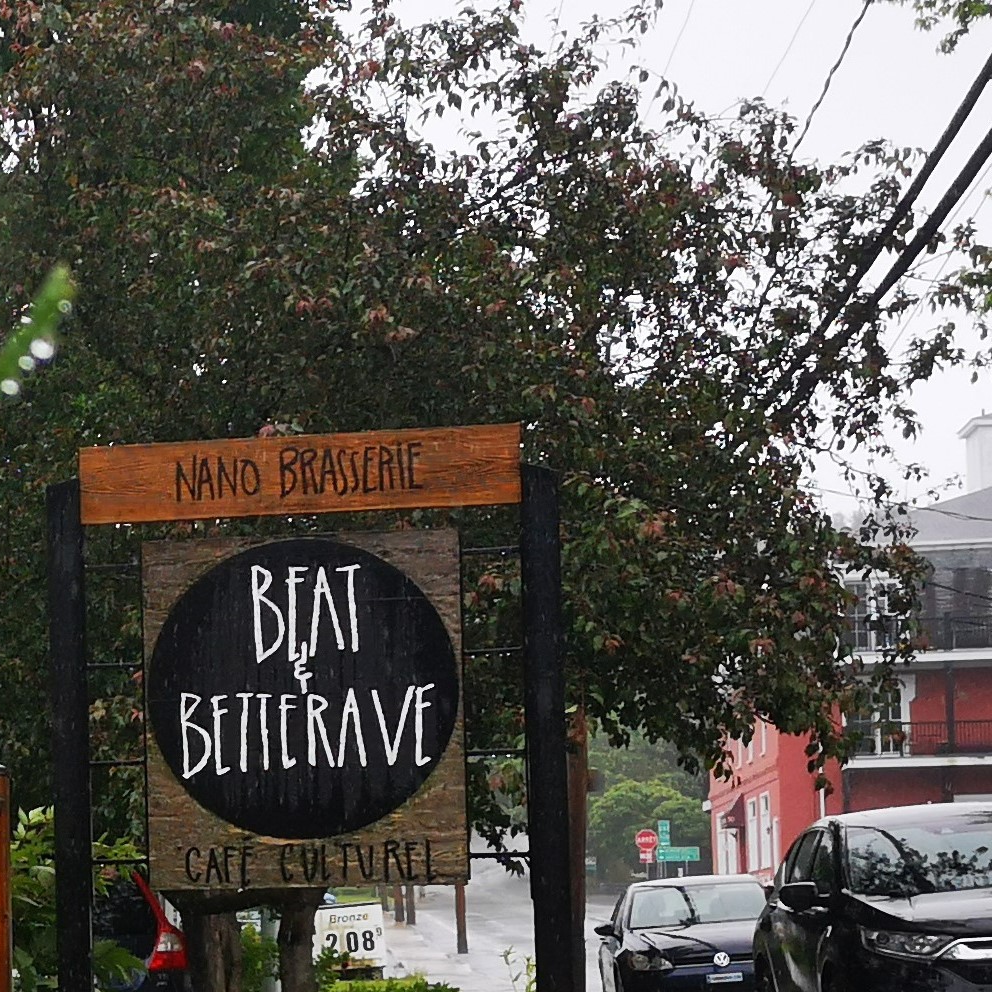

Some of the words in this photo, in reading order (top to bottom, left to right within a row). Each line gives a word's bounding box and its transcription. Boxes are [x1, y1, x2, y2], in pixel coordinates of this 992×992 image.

[175, 454, 260, 501] NANO
[279, 441, 424, 499] BRASSERIE
[251, 564, 361, 664] BEAT
[180, 683, 435, 780] BETTERAVE
[280, 839, 437, 883] CULTUREL
[329, 914, 369, 924] Bronze
